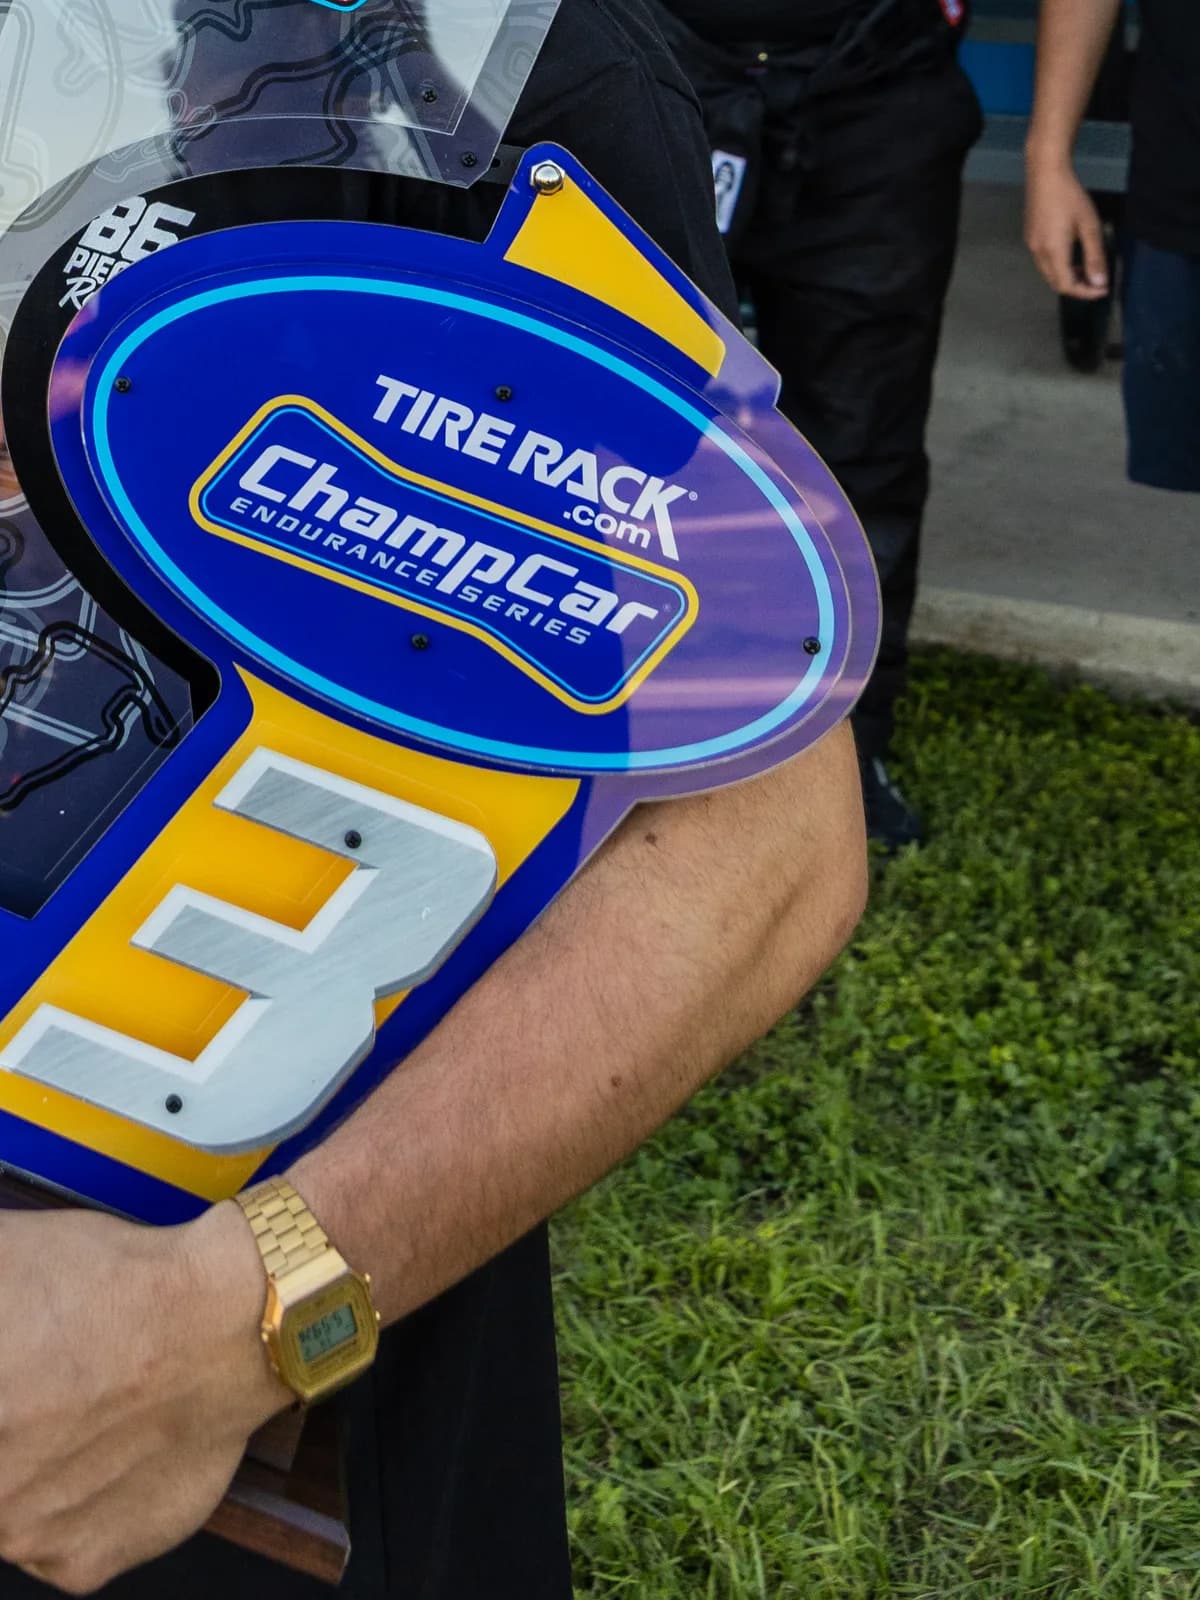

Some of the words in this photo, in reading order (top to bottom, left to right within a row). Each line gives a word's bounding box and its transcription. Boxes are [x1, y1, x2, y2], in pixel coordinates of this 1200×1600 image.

[78, 195, 197, 264] 86
[58, 276, 101, 311] R
[373, 374, 516, 464] TIRE
[507, 430, 689, 561] RACK
[230, 496, 438, 588] ENDURANCE
[457, 586, 592, 645] SERIES
[238, 444, 659, 635] ChampCar
[563, 505, 651, 549] .com
